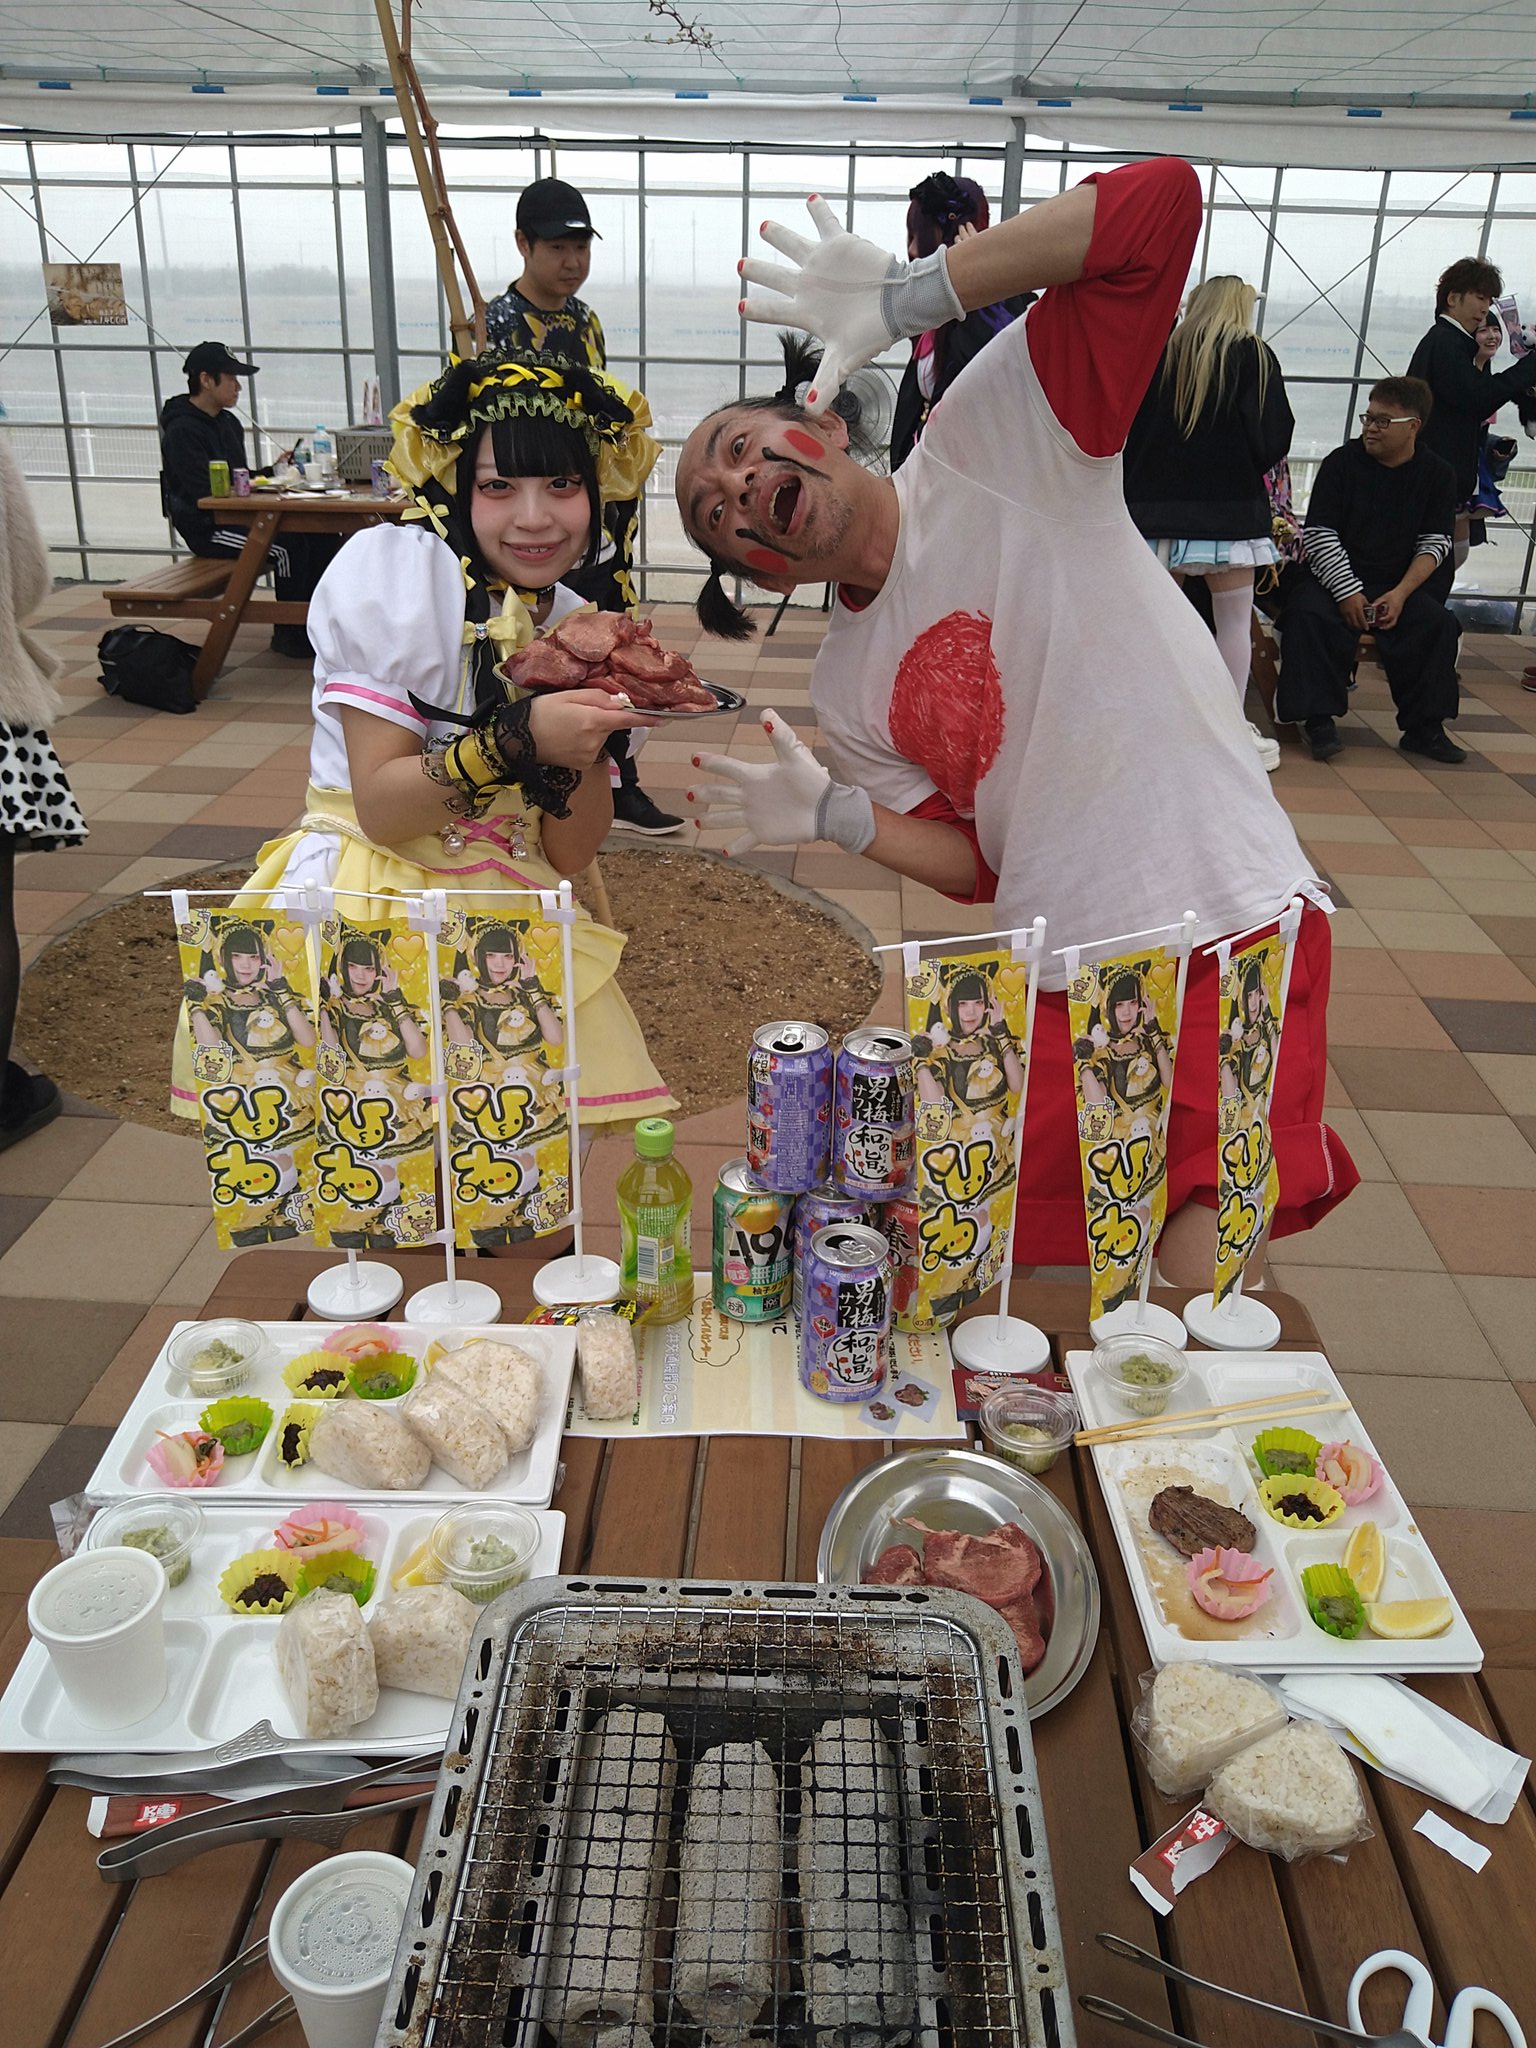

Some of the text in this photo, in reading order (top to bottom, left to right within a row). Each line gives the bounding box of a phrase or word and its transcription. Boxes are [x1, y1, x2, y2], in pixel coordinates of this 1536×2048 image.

[852, 1084, 867, 1121] サワー
[862, 1076, 890, 1123] 男梅
[751, 1260, 789, 1285] 無糖
[838, 1291, 855, 1328] サワー
[850, 1278, 878, 1329] 男梅
[660, 1324, 681, 1425] 公共交通機関のご案内
